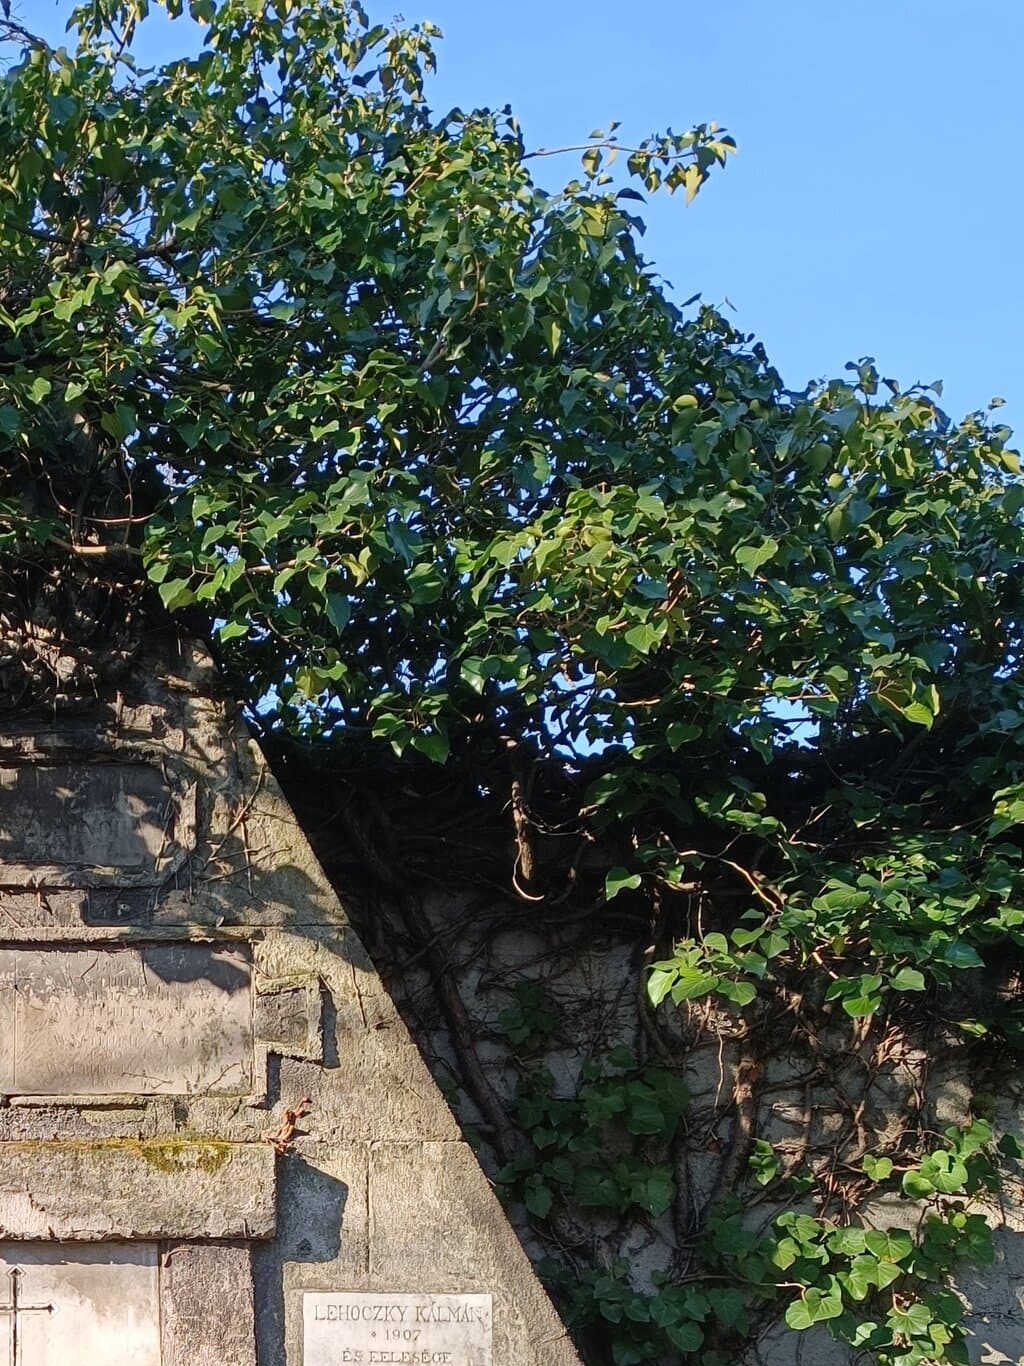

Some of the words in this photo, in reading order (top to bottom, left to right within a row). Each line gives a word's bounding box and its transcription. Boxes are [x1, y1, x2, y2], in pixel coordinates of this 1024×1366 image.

[315, 1304, 408, 1322] LEHOCZKY
[385, 1329, 422, 1341] 1907
[342, 1348, 363, 1363] ÉS
[370, 1348, 453, 1364] FELESÉGE
